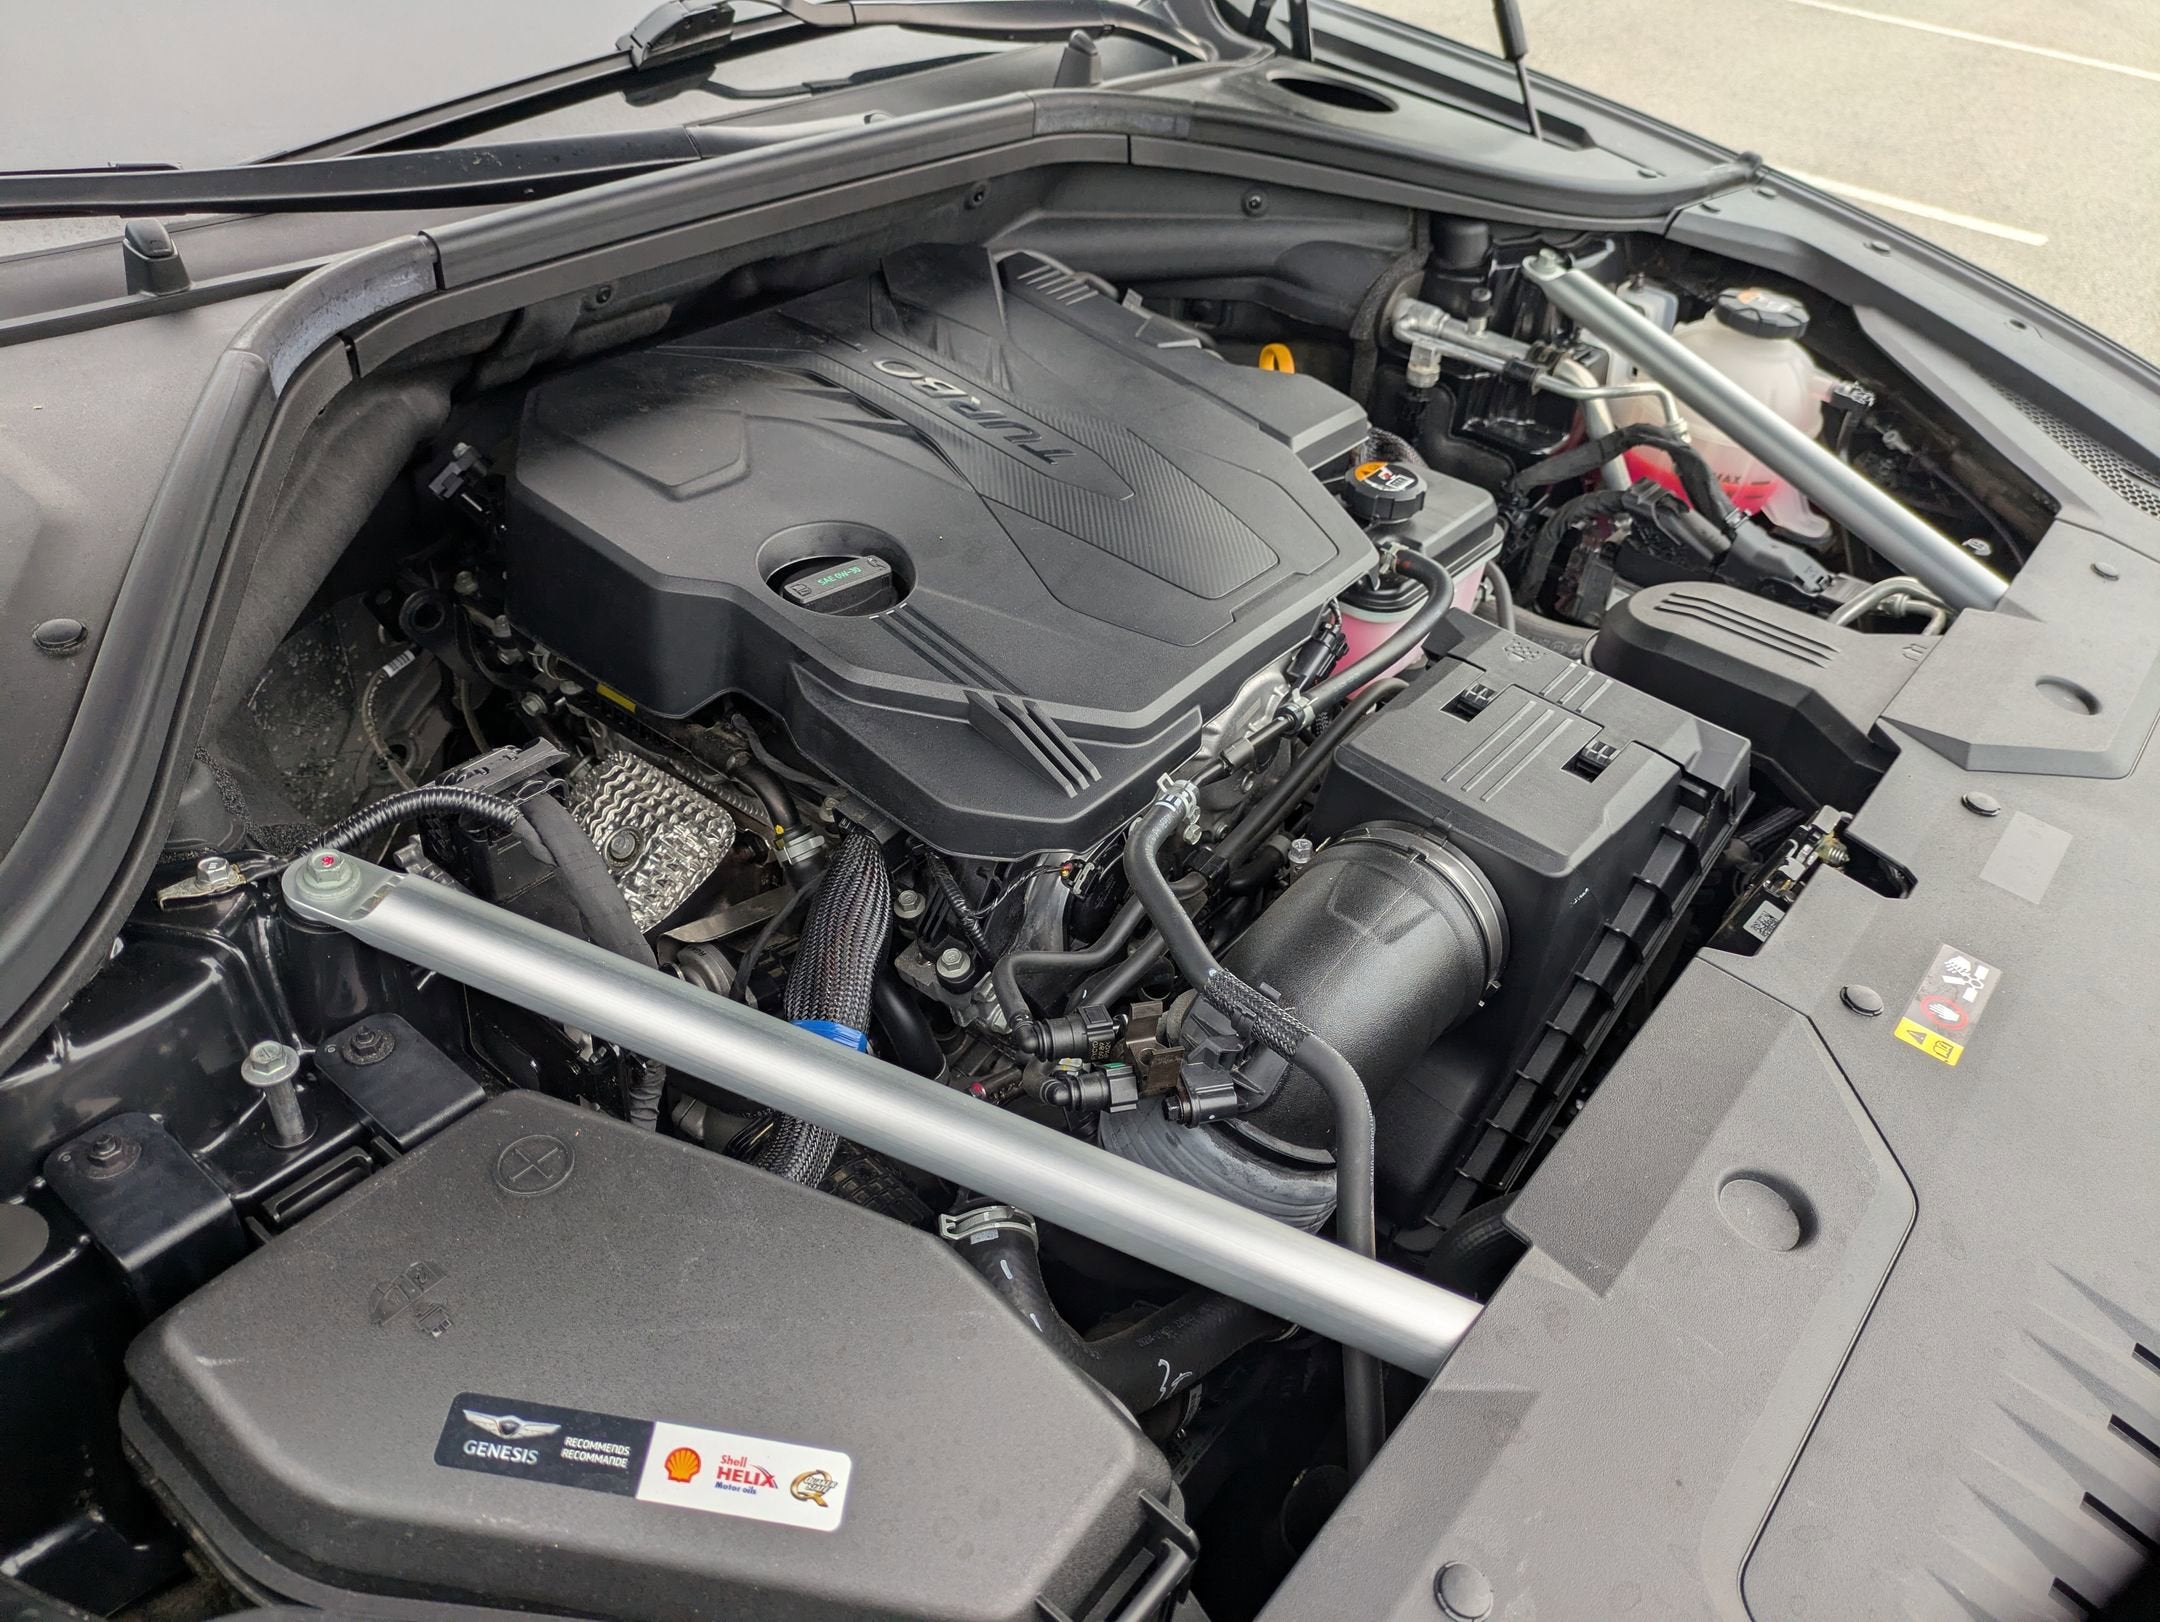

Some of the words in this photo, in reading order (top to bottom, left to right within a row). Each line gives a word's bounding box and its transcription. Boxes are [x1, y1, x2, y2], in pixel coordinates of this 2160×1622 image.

[872, 358, 1077, 465] TURBO
[818, 576, 836, 585] SAE
[463, 1440, 539, 1465] GENESIS
[720, 1454, 748, 1468] Shell
[716, 1466, 775, 1488] HELIX
[715, 1481, 741, 1492] Motor
[742, 1485, 757, 1495] oils
